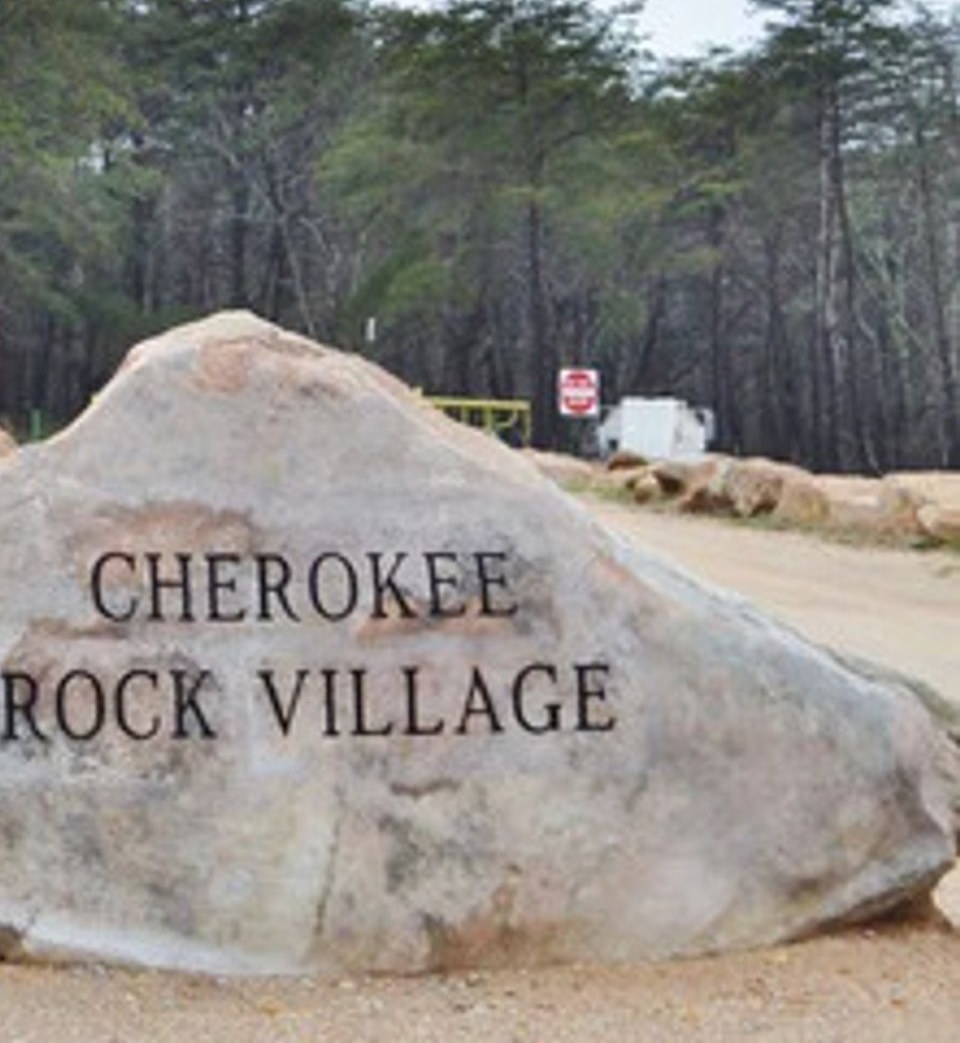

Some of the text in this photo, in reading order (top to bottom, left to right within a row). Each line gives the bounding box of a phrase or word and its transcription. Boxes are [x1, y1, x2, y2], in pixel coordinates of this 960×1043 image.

[90, 552, 519, 622] CHEROKEE
[1, 664, 617, 741] ROCK VILLAGE
